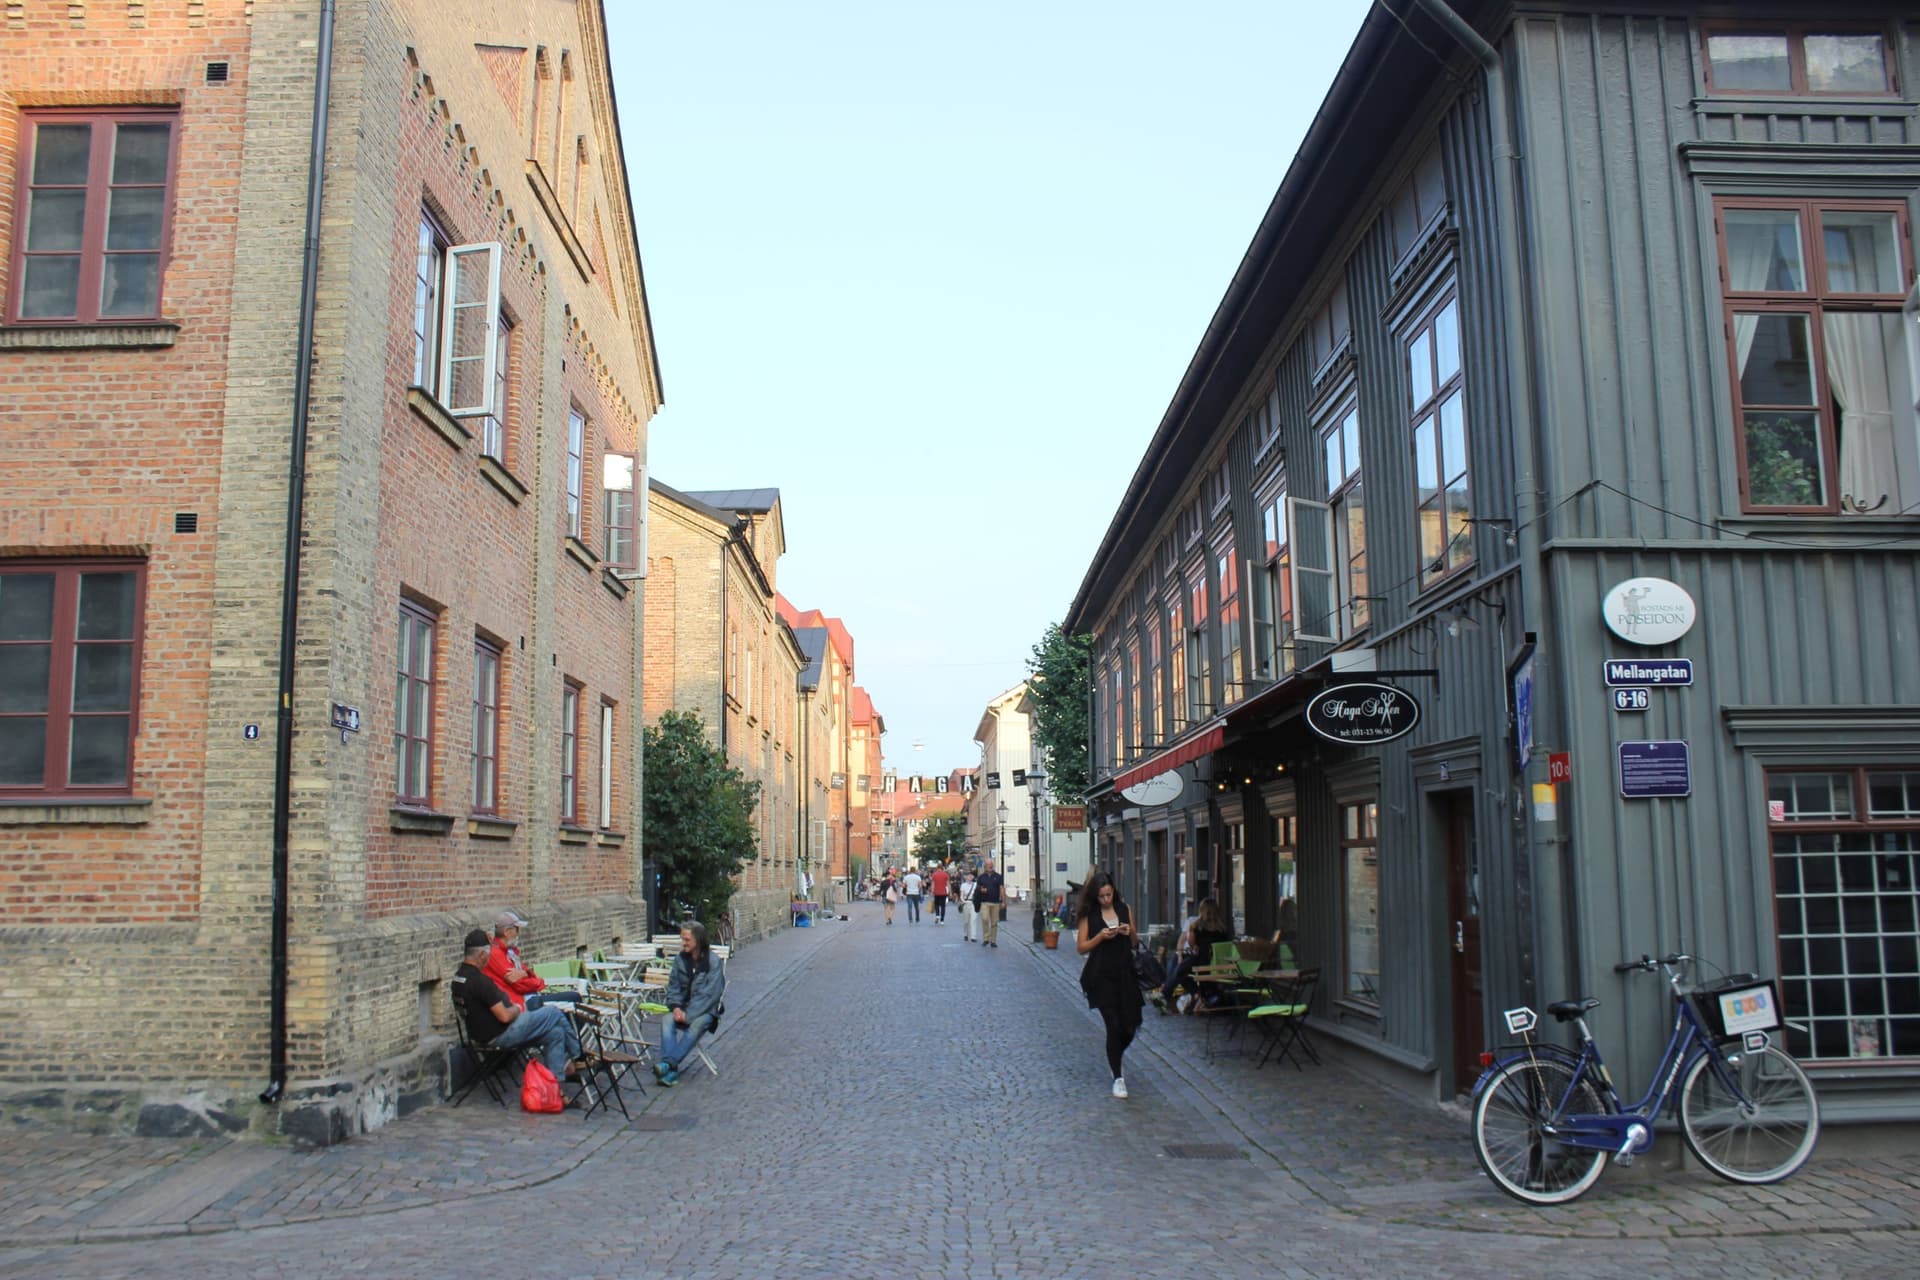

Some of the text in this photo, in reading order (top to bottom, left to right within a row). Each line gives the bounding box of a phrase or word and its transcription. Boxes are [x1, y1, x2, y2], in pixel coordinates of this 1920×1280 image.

[1618, 613, 1686, 625] POSEIDON
[1611, 664, 1688, 682] Mellangatan
[1617, 691, 1647, 708] 6-16
[1322, 699, 1361, 721] Haga
[247, 726, 255, 738] 4
[1551, 761, 1563, 777] 10
[885, 775, 974, 793] HAGA
